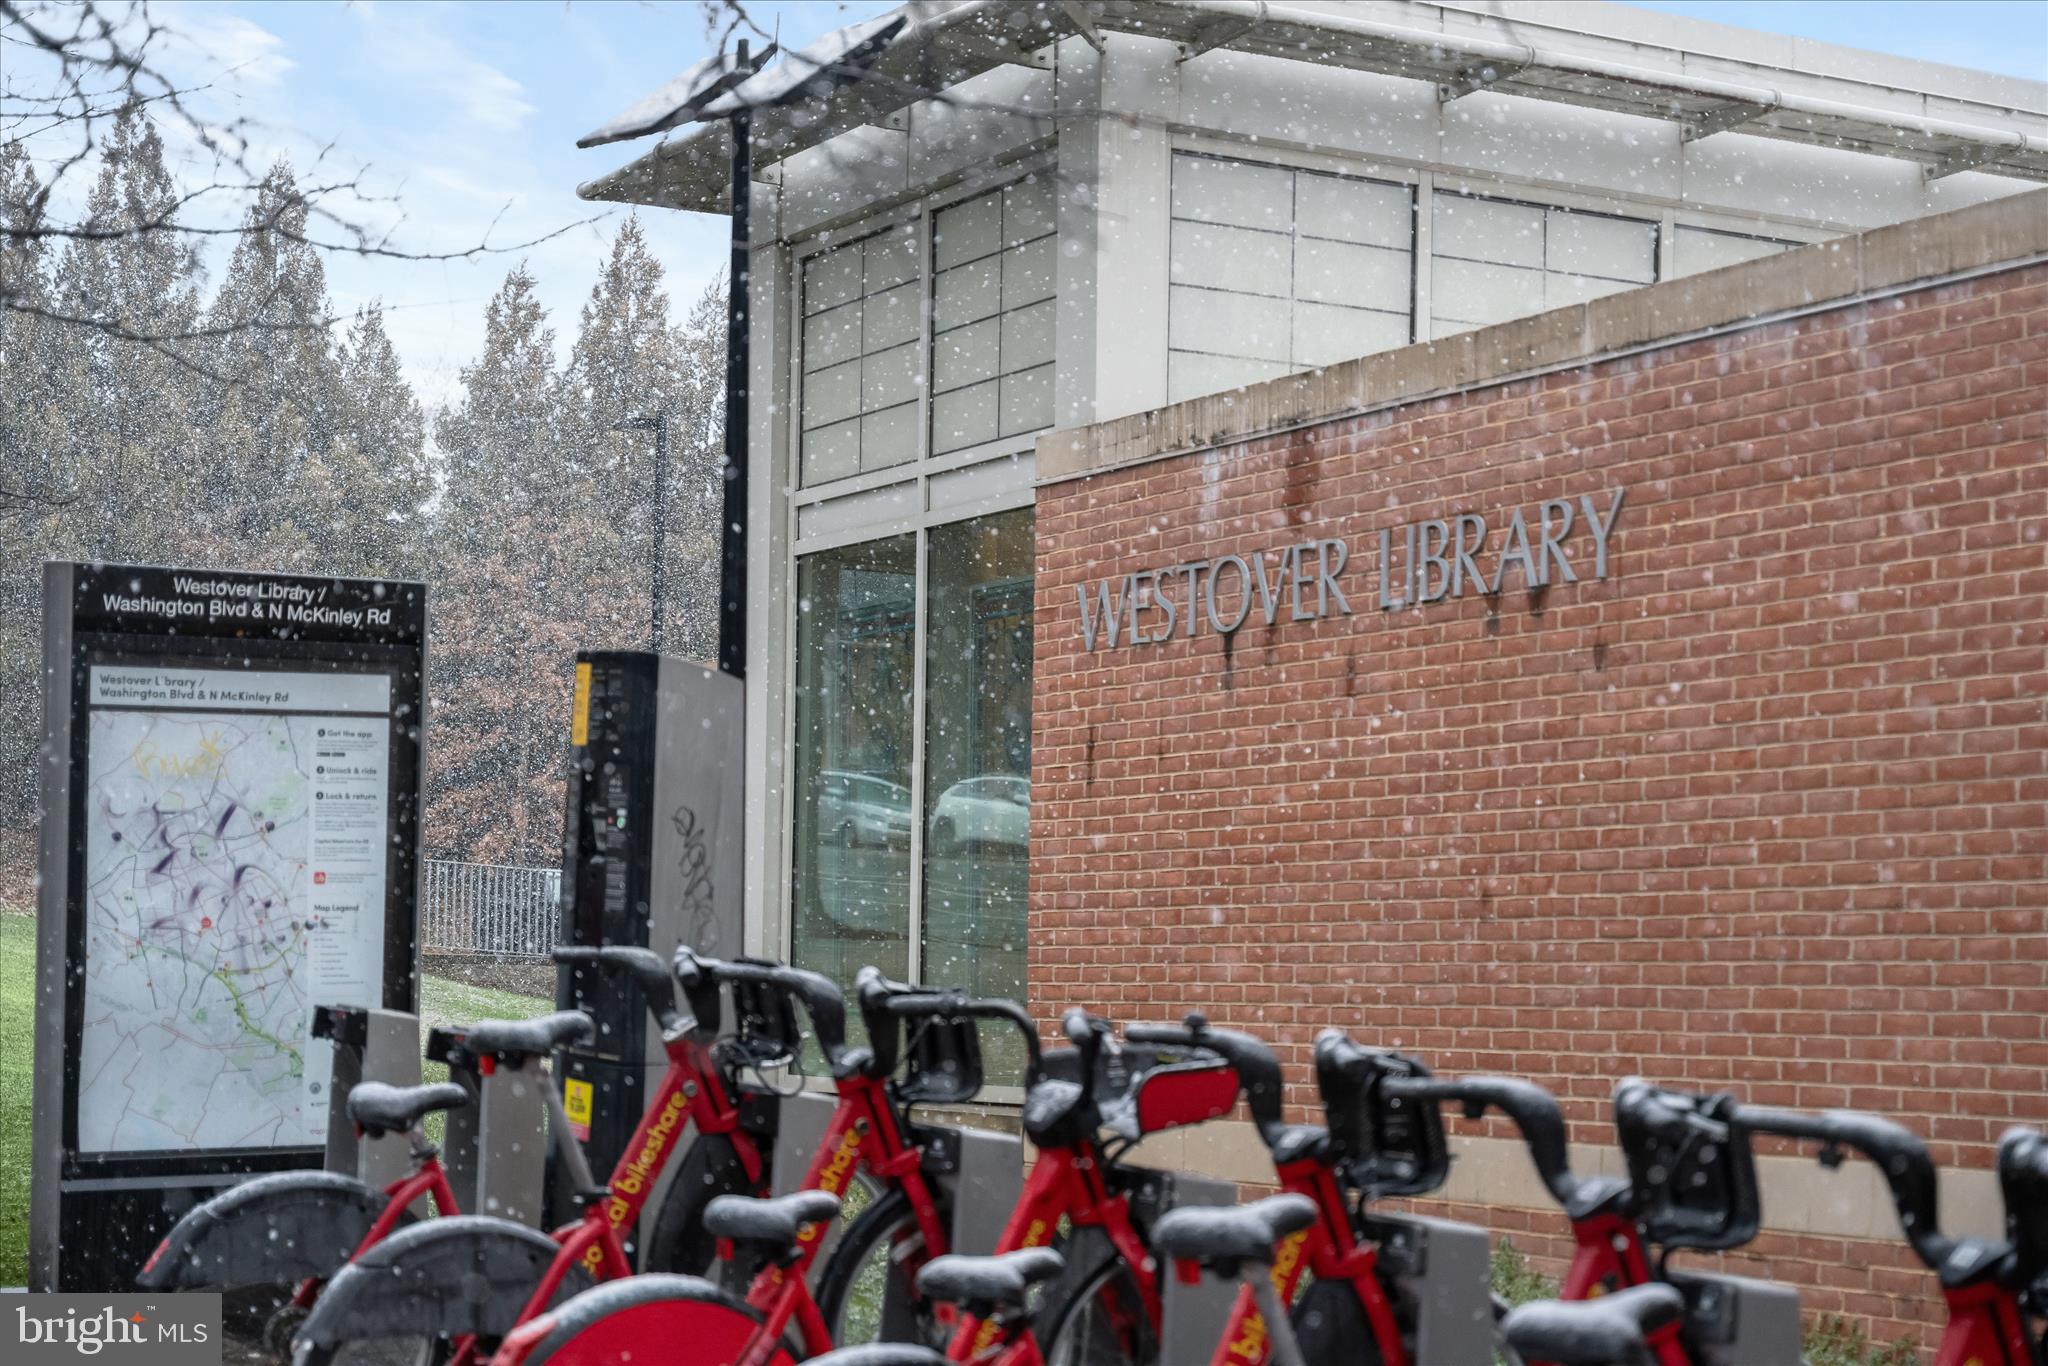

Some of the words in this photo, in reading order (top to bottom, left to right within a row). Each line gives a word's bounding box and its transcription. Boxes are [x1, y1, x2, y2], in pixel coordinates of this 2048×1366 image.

[1077, 539, 1351, 651] WESTOVER
[1379, 485, 1625, 609] LIBRARY
[173, 576, 252, 597] Westover
[258, 581, 316, 605] Library
[318, 586, 327, 603] /
[103, 594, 204, 617] Washington
[209, 599, 247, 617] Blvd
[251, 602, 264, 618] &
[269, 603, 283, 620] N
[287, 604, 363, 627] McKinley
[367, 608, 391, 625] Rd
[100, 674, 152, 685] Westover
[100, 688, 166, 701] Washington
[170, 689, 195, 700] Blvd
[210, 691, 218, 701] N
[221, 691, 272, 704] McKinley
[274, 692, 289, 703] Rd
[614, 1090, 688, 1195] bikeshare
